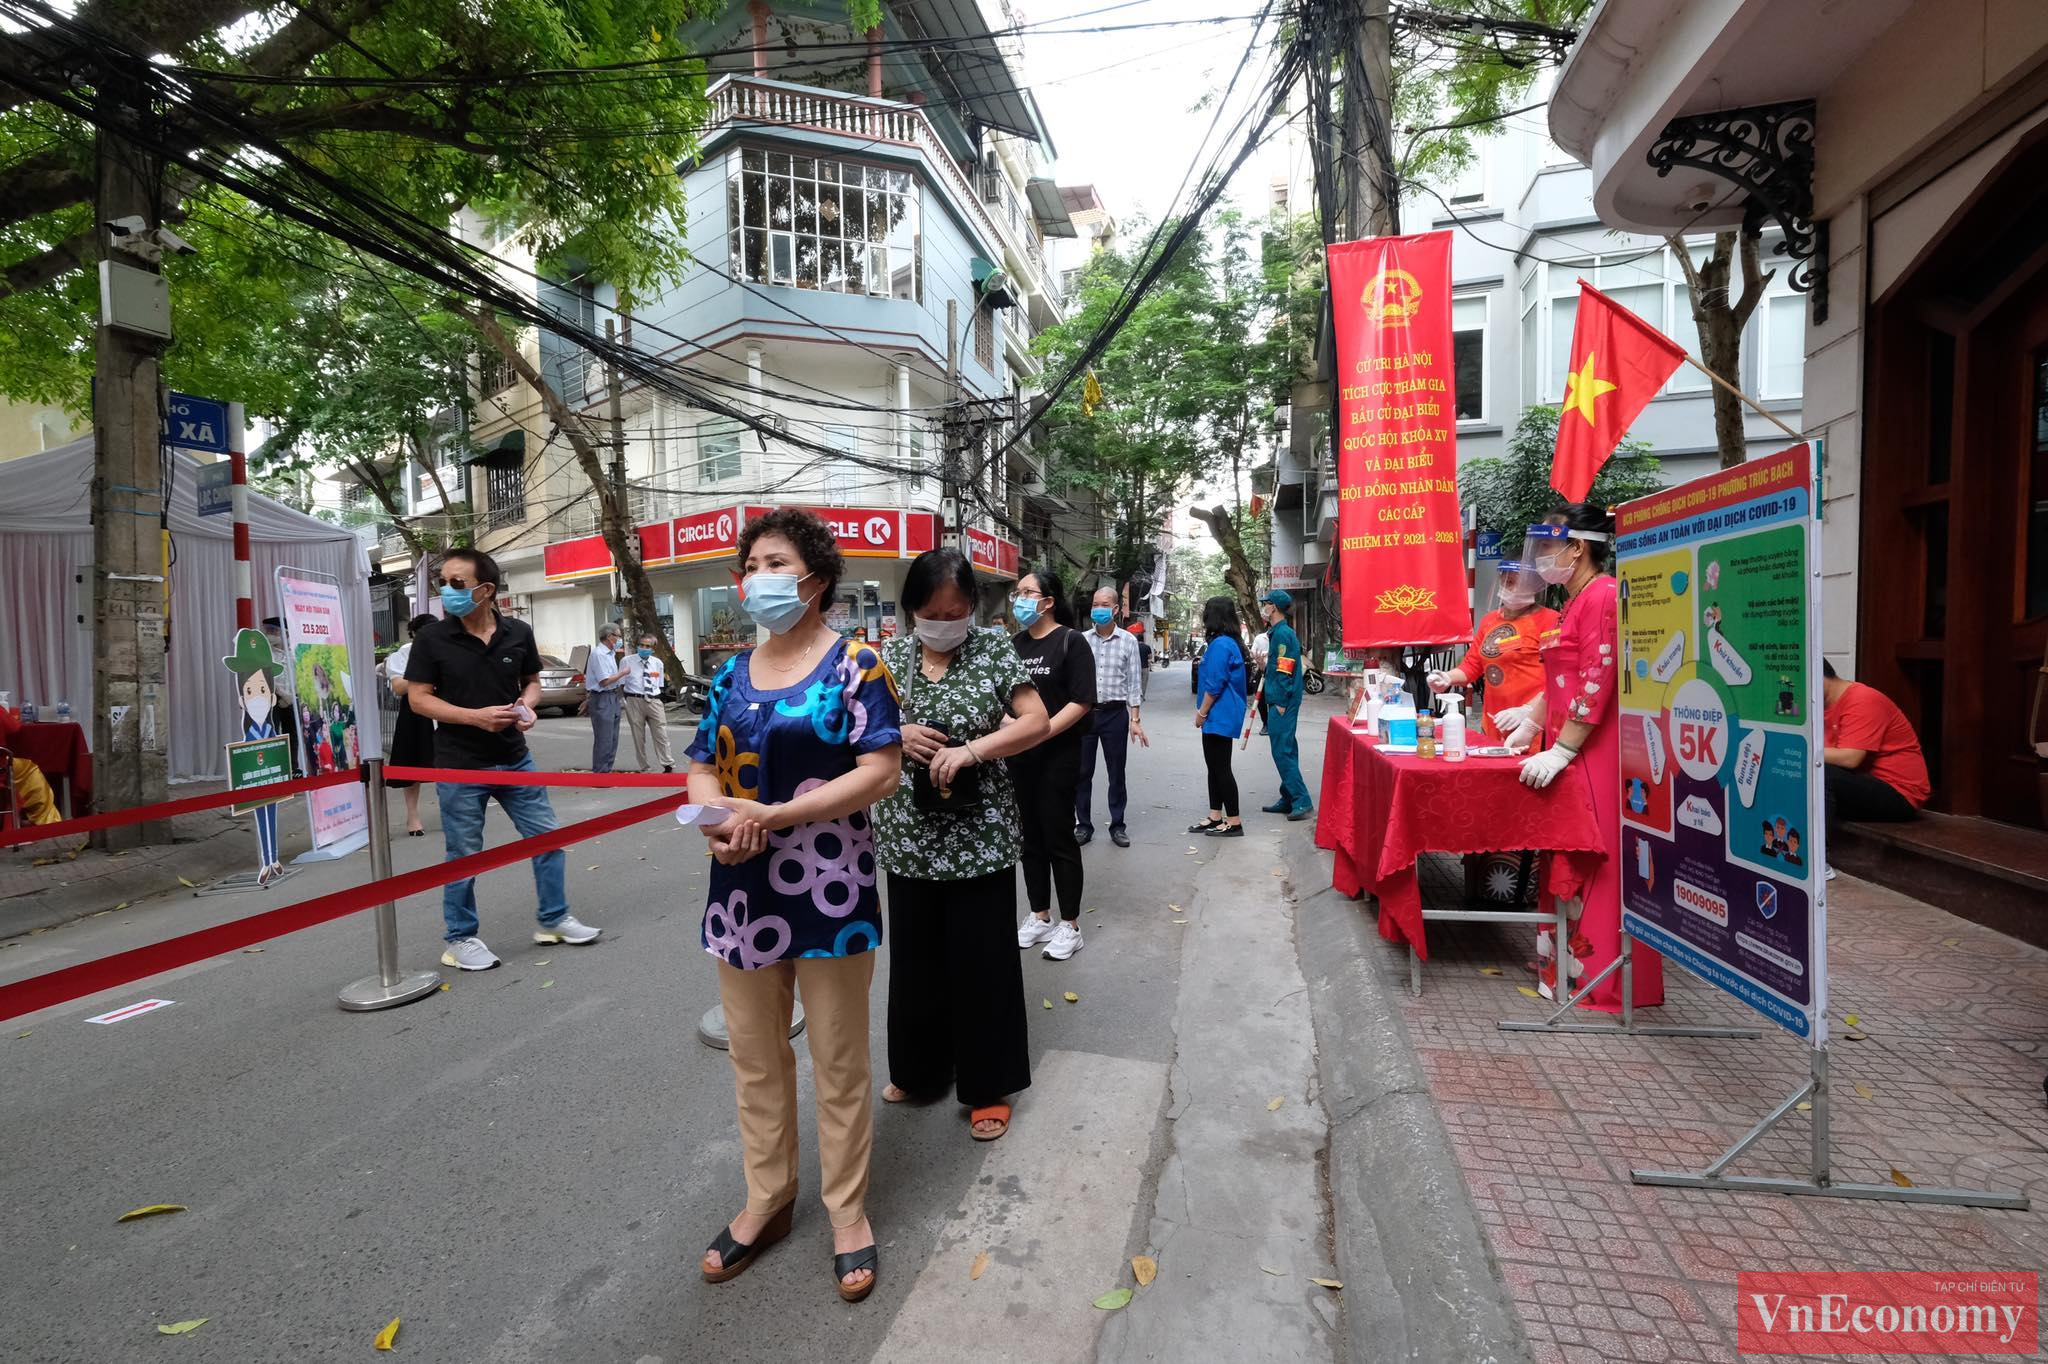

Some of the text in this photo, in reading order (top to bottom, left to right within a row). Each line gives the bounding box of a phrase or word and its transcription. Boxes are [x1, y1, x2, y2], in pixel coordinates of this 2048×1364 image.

[1356, 349, 1432, 373] CỬ TRI HÀ NỘI
[1343, 378, 1446, 400] TÍCH CỰC THAM GIA
[169, 404, 190, 416] HỐ
[1377, 402, 1391, 420] CỬ
[1393, 405, 1414, 421] ĐẠI
[1416, 396, 1440, 416] BIỂU
[179, 421, 216, 443] XÃ
[1344, 430, 1375, 450] QUỐC
[1378, 429, 1398, 448] HỘI
[1434, 429, 1448, 442] XV
[1365, 446, 1433, 473] VÀ ĐẠI BIỂU
[1341, 477, 1454, 502] HỘI ĐỒNG NHÂN DÂN
[1652, 499, 1671, 518] CHỐNG
[1672, 496, 1686, 514] DỊCH
[1687, 485, 1716, 508] COVID-19
[1718, 475, 1747, 498] PHƯỜNG
[1748, 467, 1769, 489] TRÚC
[1771, 460, 1793, 484] BẠCH
[1378, 501, 1426, 521] CÁC CẤP
[678, 522, 714, 543] CIRCLE
[1616, 496, 1796, 553] CHUNG SỐNG AN TOÀN VỚI ĐẠI DỊCH COVID-19
[1342, 533, 1381, 551] NHIỆM
[1384, 530, 1400, 547] KỲ
[1404, 533, 1426, 545] 2021
[1479, 545, 1498, 557] LẠC
[1674, 706, 1722, 725] THÔNG ĐIỆP
[1680, 723, 1718, 765] 5K
[1746, 752, 1761, 786] Không
[1676, 884, 1726, 918] 19009095
[1739, 984, 1750, 998] đại
[1767, 1000, 1804, 1029] COVID-19
